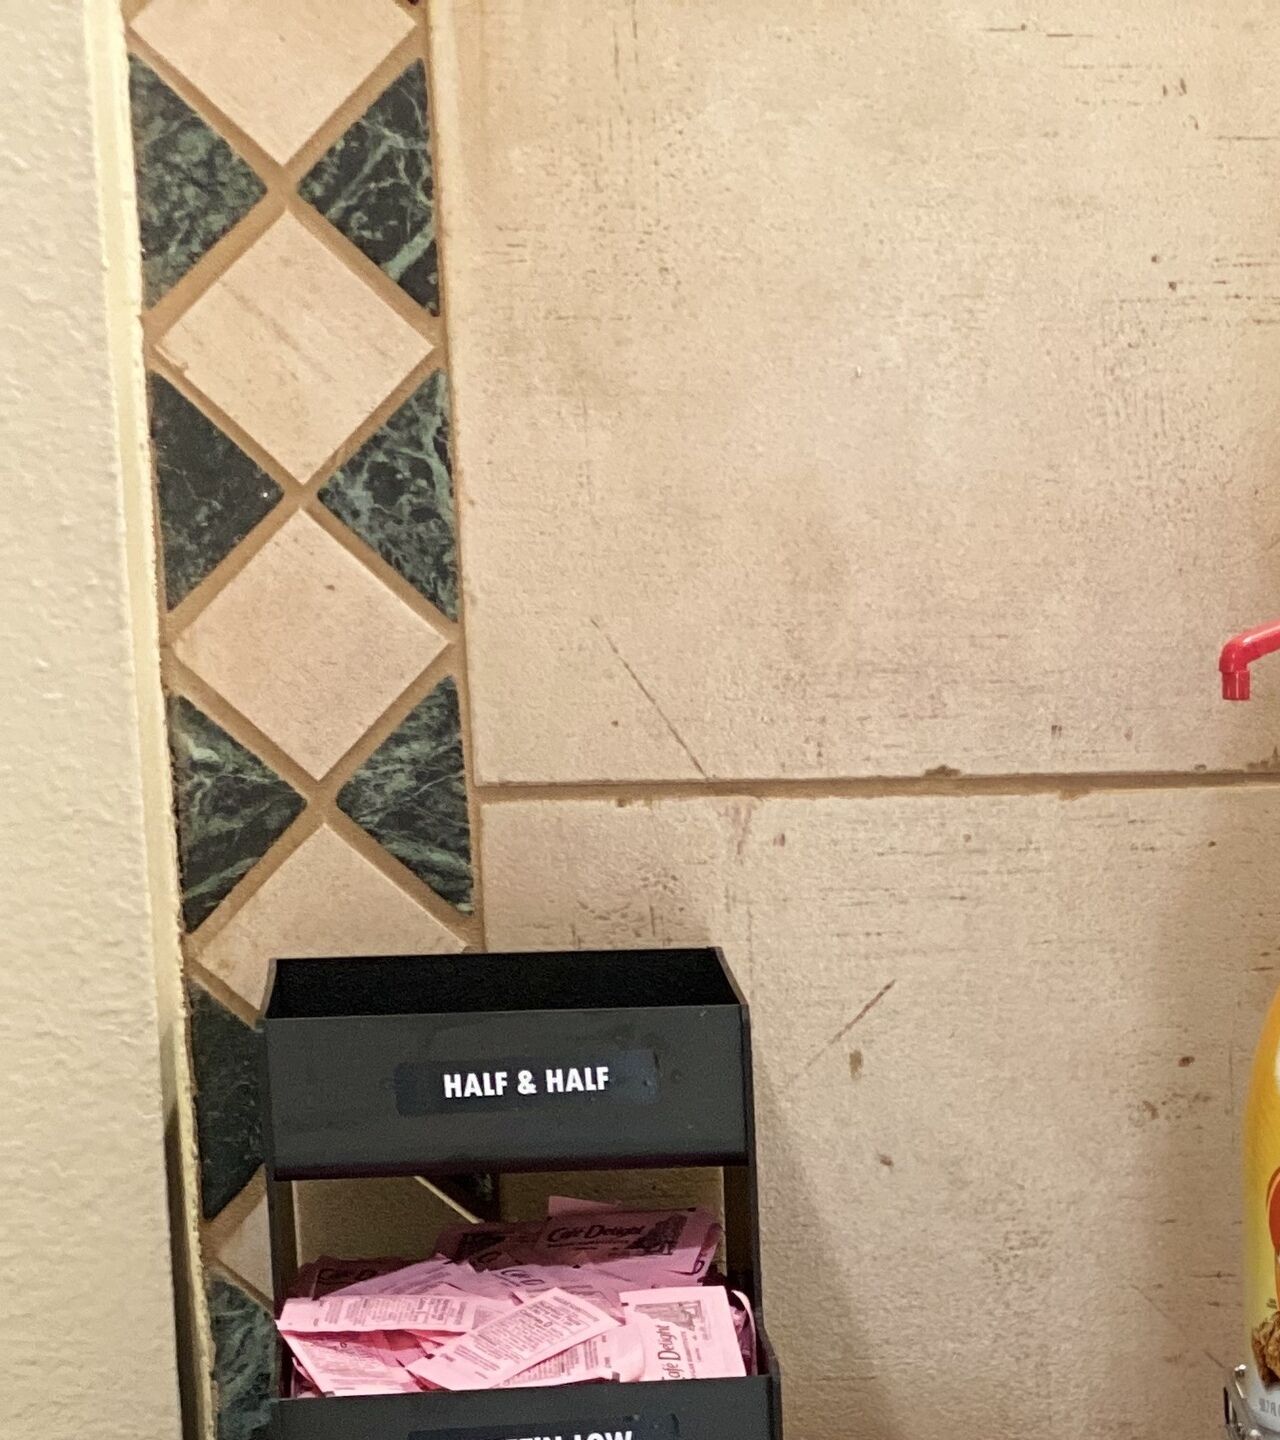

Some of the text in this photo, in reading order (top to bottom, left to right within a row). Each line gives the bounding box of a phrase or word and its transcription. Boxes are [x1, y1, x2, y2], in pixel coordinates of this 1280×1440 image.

[443, 1066, 609, 1098] HALF & HALF
